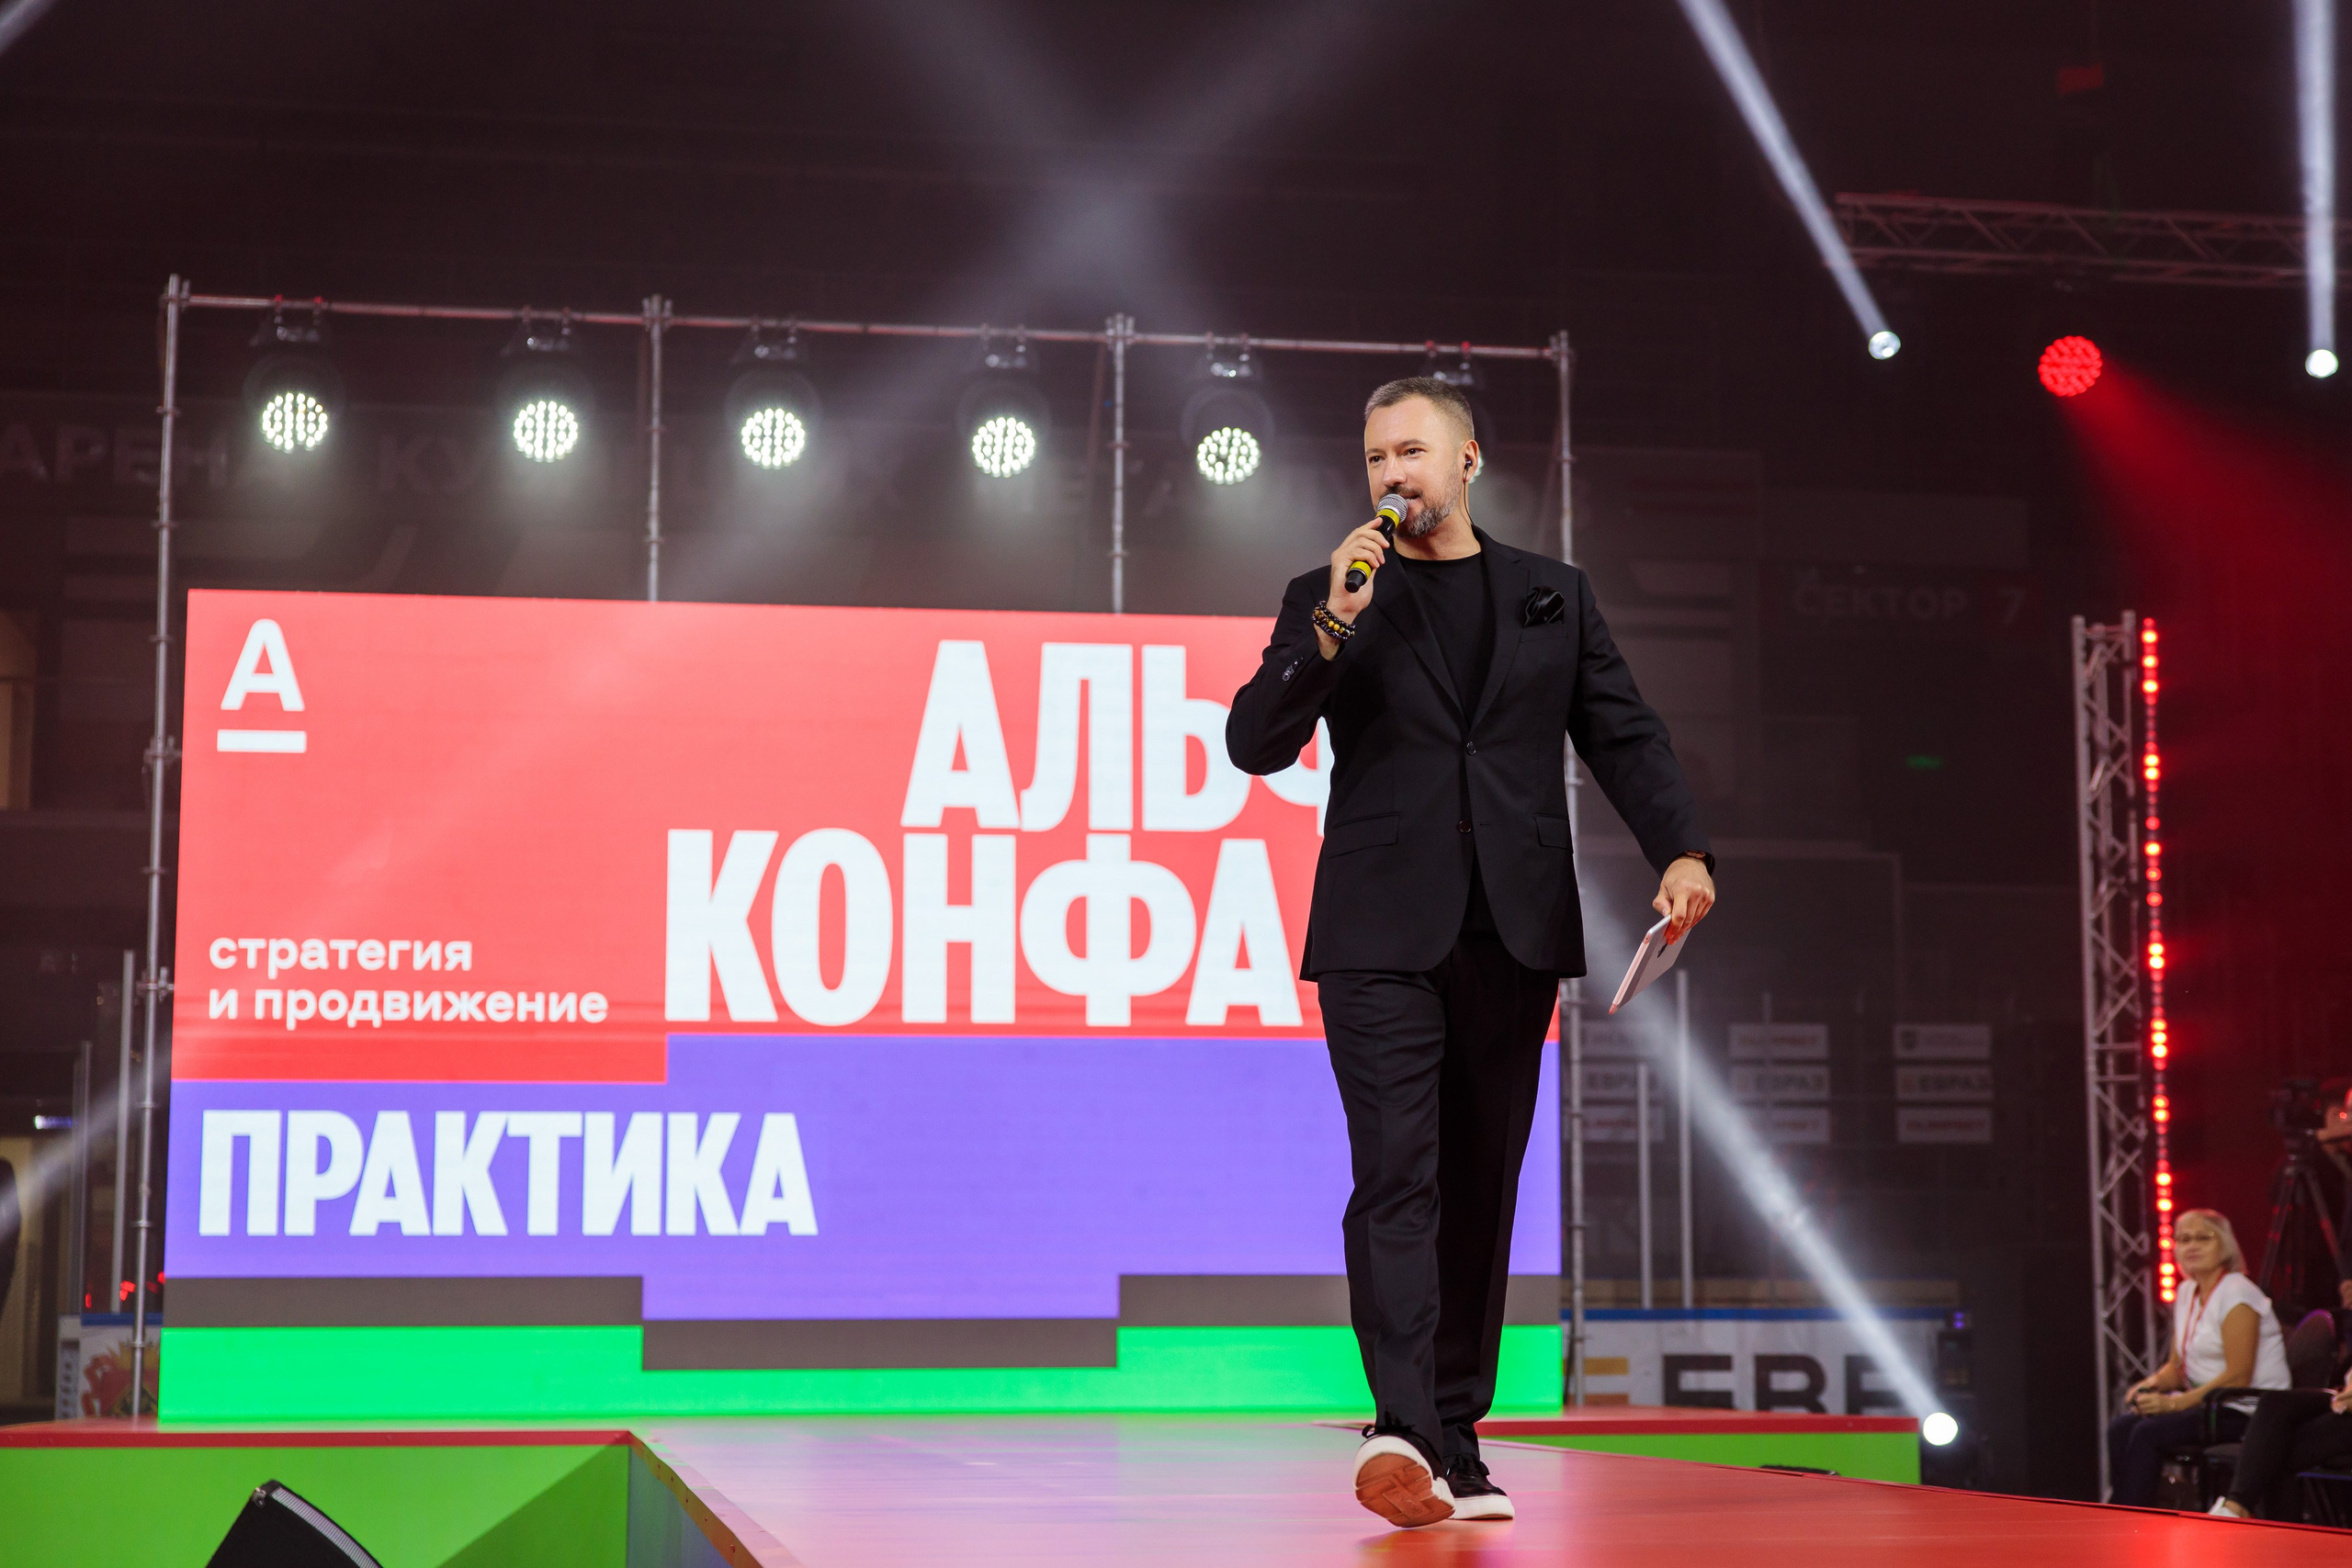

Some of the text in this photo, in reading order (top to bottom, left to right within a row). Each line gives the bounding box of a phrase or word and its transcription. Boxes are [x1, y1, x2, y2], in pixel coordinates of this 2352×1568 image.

[220, 618, 305, 712] А
[209, 937, 472, 978] стратегия
[664, 828, 1304, 1027] КОНФА
[209, 988, 608, 1030] и продвижение
[198, 1109, 819, 1237] ПРАКТИКА
